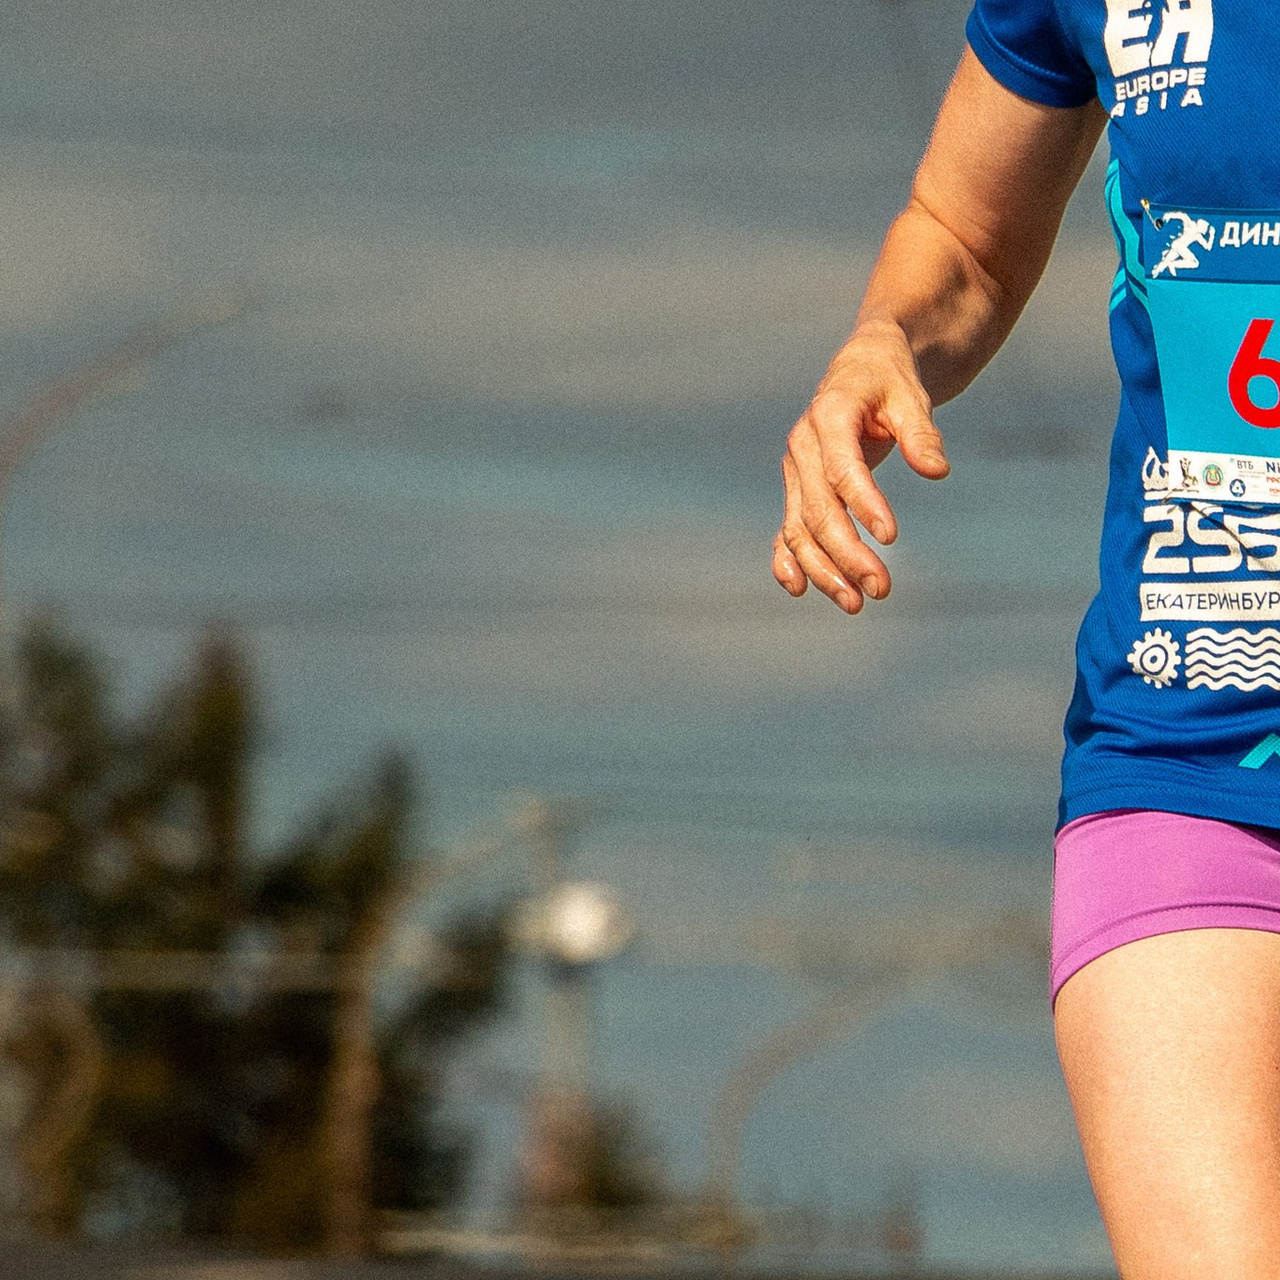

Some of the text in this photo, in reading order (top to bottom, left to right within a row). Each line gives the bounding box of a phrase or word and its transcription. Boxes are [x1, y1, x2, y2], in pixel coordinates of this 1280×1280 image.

[1115, 67, 1207, 102] EUROPE
[1110, 88, 1203, 119] ASIA
[1236, 459, 1255, 470] ВТБ
